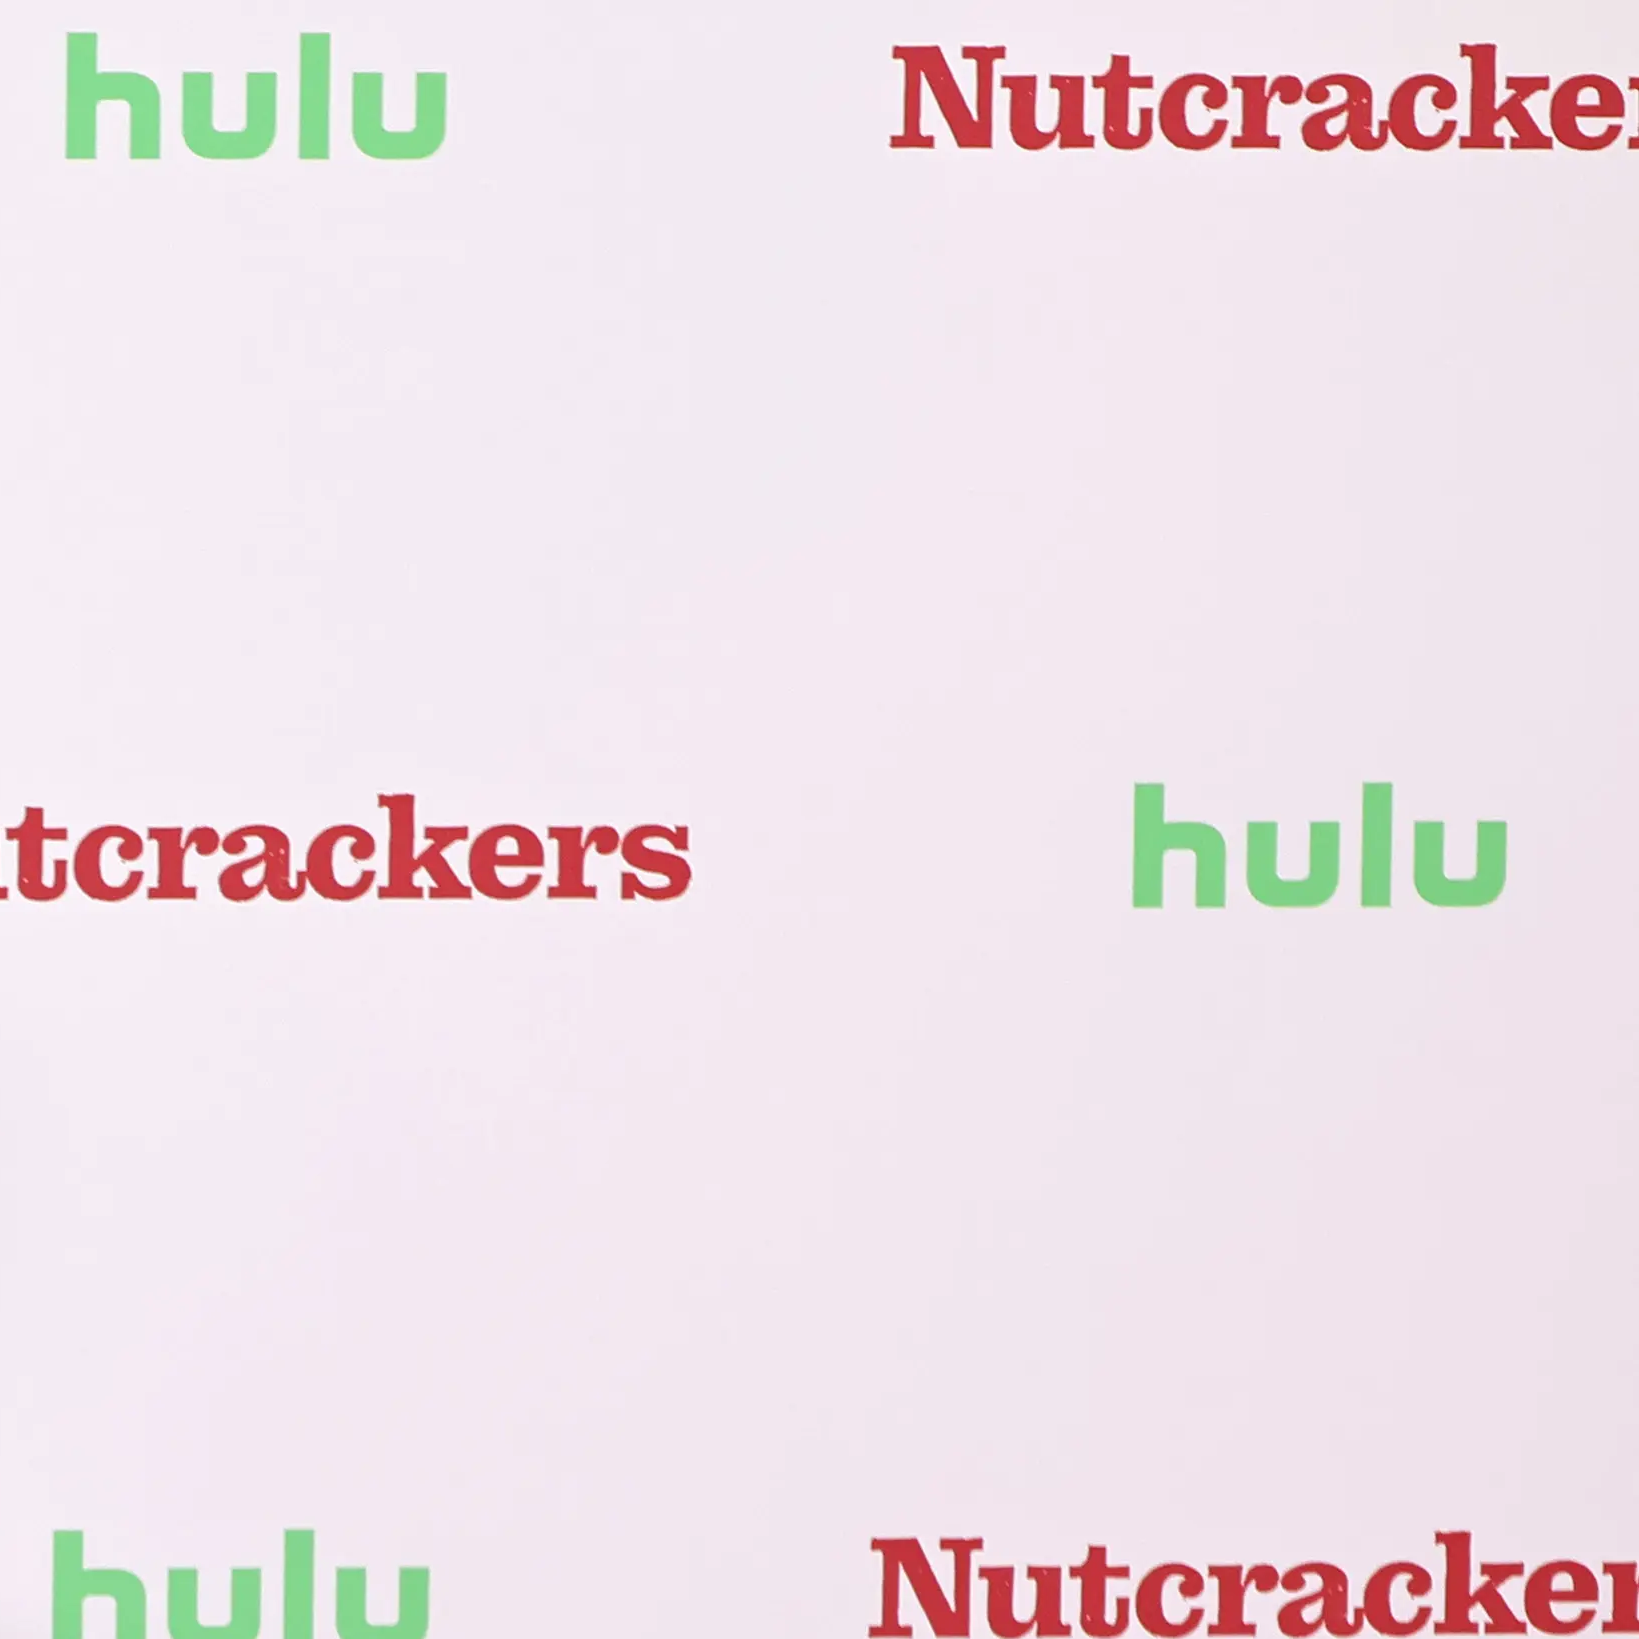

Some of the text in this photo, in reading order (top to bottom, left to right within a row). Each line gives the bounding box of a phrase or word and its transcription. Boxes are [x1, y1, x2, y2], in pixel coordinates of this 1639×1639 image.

[66, 32, 447, 160] hulu
[890, 43, 1639, 152] Nutcracke
[1132, 782, 1508, 909] hulu
